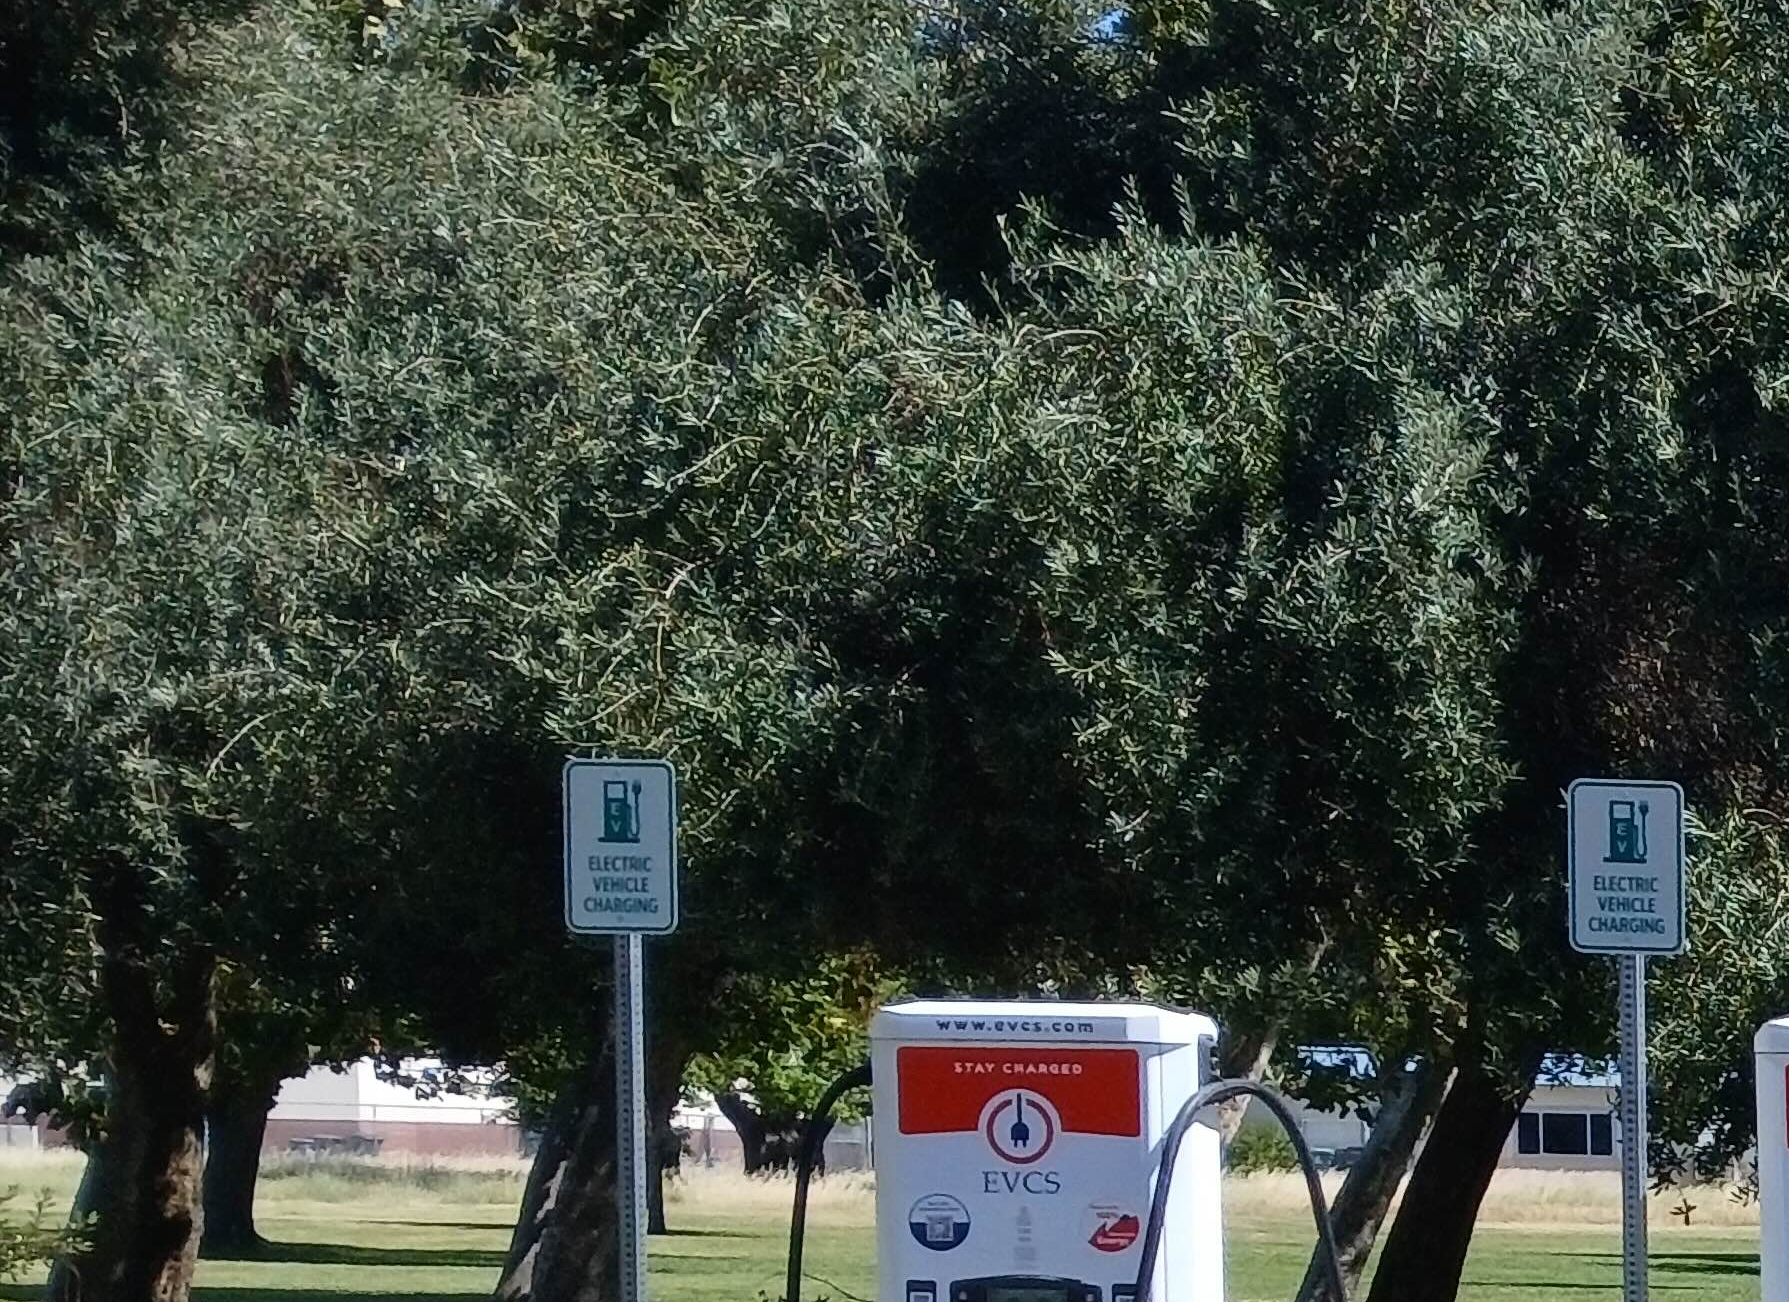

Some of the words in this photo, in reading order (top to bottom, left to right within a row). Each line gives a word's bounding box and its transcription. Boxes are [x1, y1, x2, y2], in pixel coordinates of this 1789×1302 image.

[588, 855, 653, 872] ELECTRIC
[593, 877, 649, 893] VEHICLE
[1594, 875, 1658, 892] ELECTRIC
[583, 897, 659, 914] CHARGING
[1597, 896, 1656, 913] VEHICLE
[1588, 917, 1666, 934] CHARGING
[936, 1019, 1094, 1034] www.evcs.com
[954, 1062, 995, 1074] STAY
[1003, 1063, 1082, 1075] CHARGED
[982, 1171, 1062, 1194] EVCS
